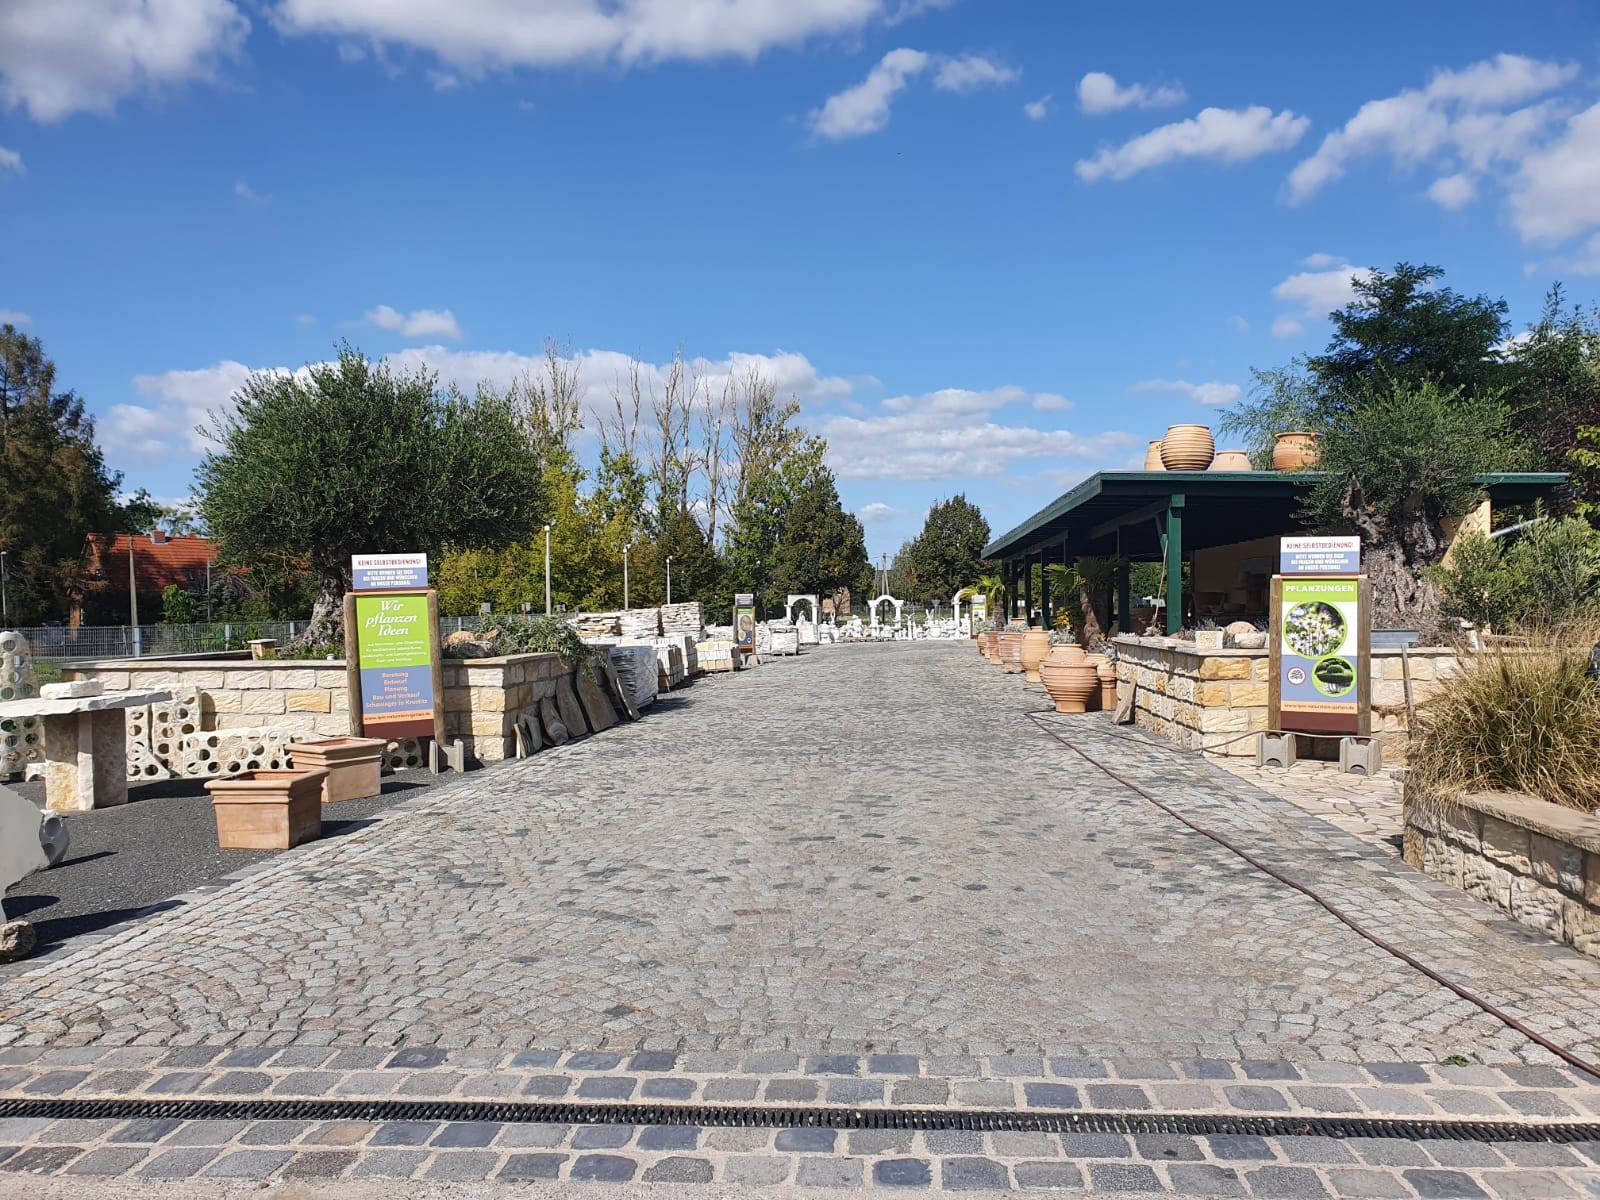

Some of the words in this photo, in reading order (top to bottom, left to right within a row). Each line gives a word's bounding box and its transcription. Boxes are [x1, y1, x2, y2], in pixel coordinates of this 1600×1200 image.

[381, 600, 404, 611] Wir
[365, 612, 418, 628] pflanzen
[378, 624, 409, 636] Ideen
